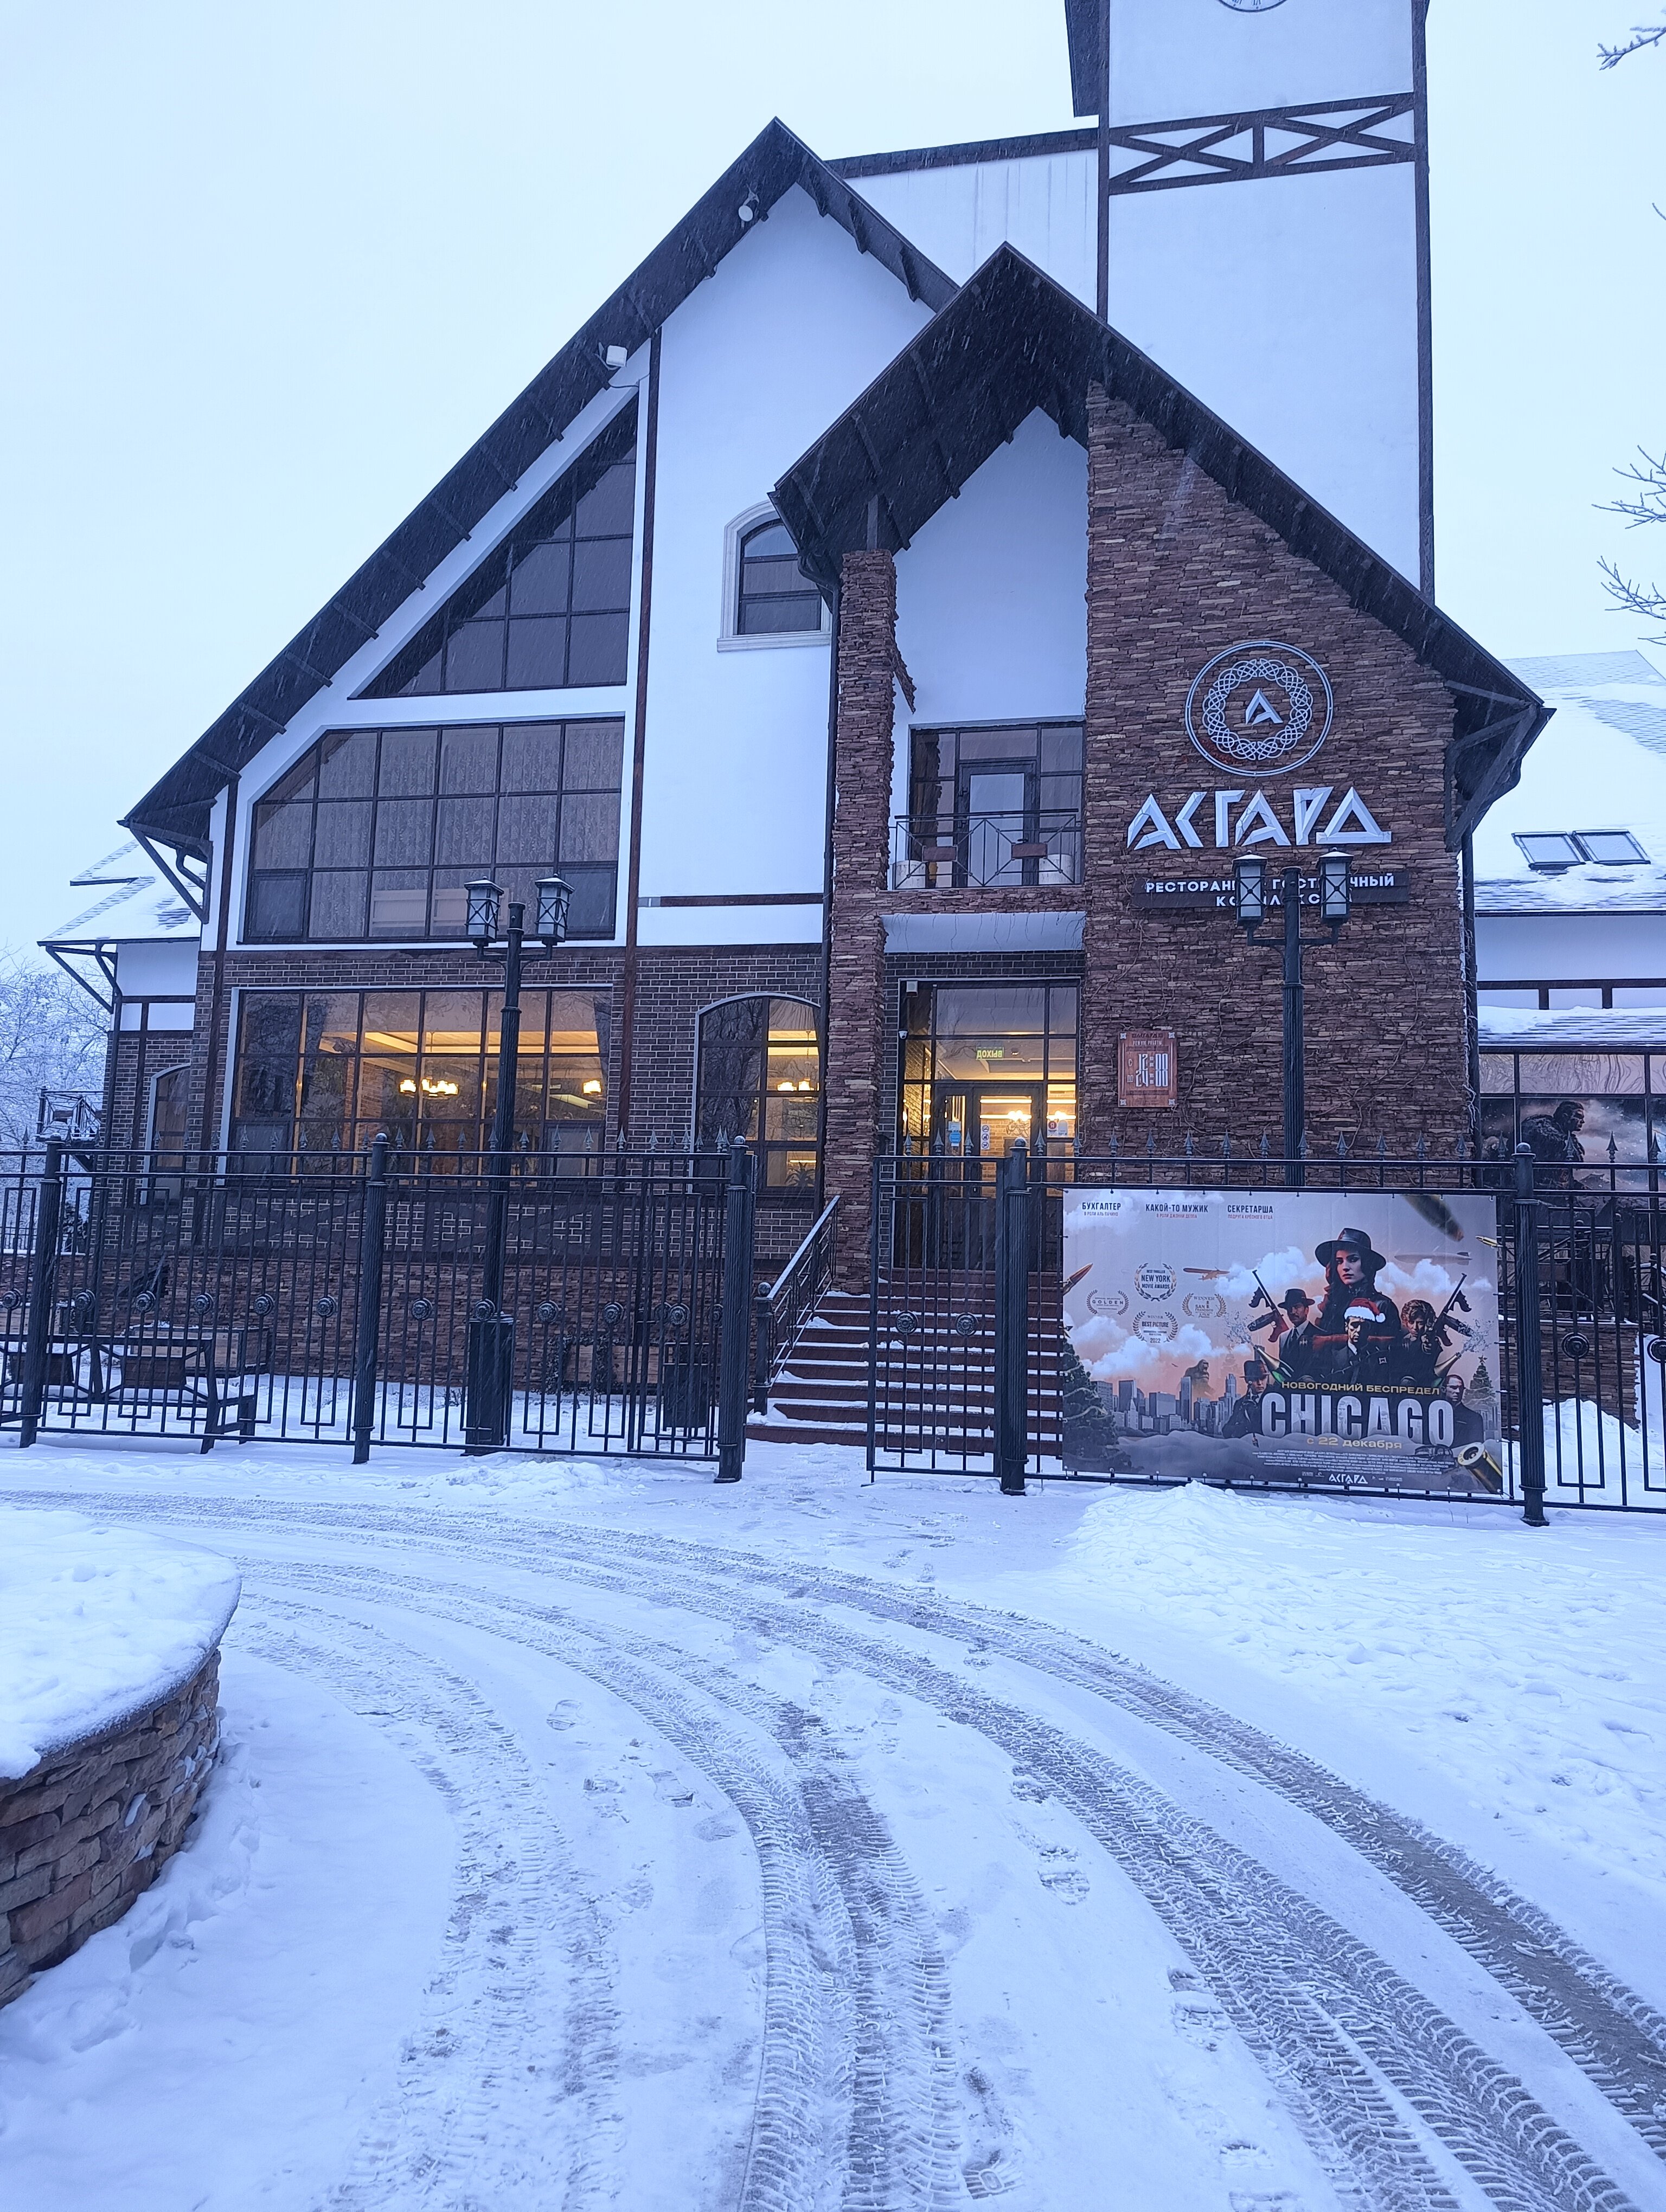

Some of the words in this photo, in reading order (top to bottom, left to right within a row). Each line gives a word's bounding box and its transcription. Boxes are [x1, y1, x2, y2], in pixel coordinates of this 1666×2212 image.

[1127, 787, 1392, 850] АСГАРД
[1138, 1053, 1168, 1070] 12:00
[1136, 1070, 1168, 1087] 24:00
[1082, 1202, 1121, 1210] БУХГАЛТЕР
[1145, 1203, 1180, 1212] КАКОЙ-ТО
[1182, 1204, 1208, 1213] МУЖИК
[1227, 1205, 1273, 1213] СЕКРЕТАРША
[1155, 1275, 1171, 1283] YORK
[1281, 1381, 1363, 1392] НОВОГОДНИЙ
[1366, 1385, 1440, 1396] БЕСПРЕДЕЛ
[1261, 1392, 1454, 1448] CHICAGO
[1318, 1437, 1339, 1446] 22
[1342, 1438, 1402, 1450] декабря
[1329, 1473, 1368, 1484] АСГАРД
